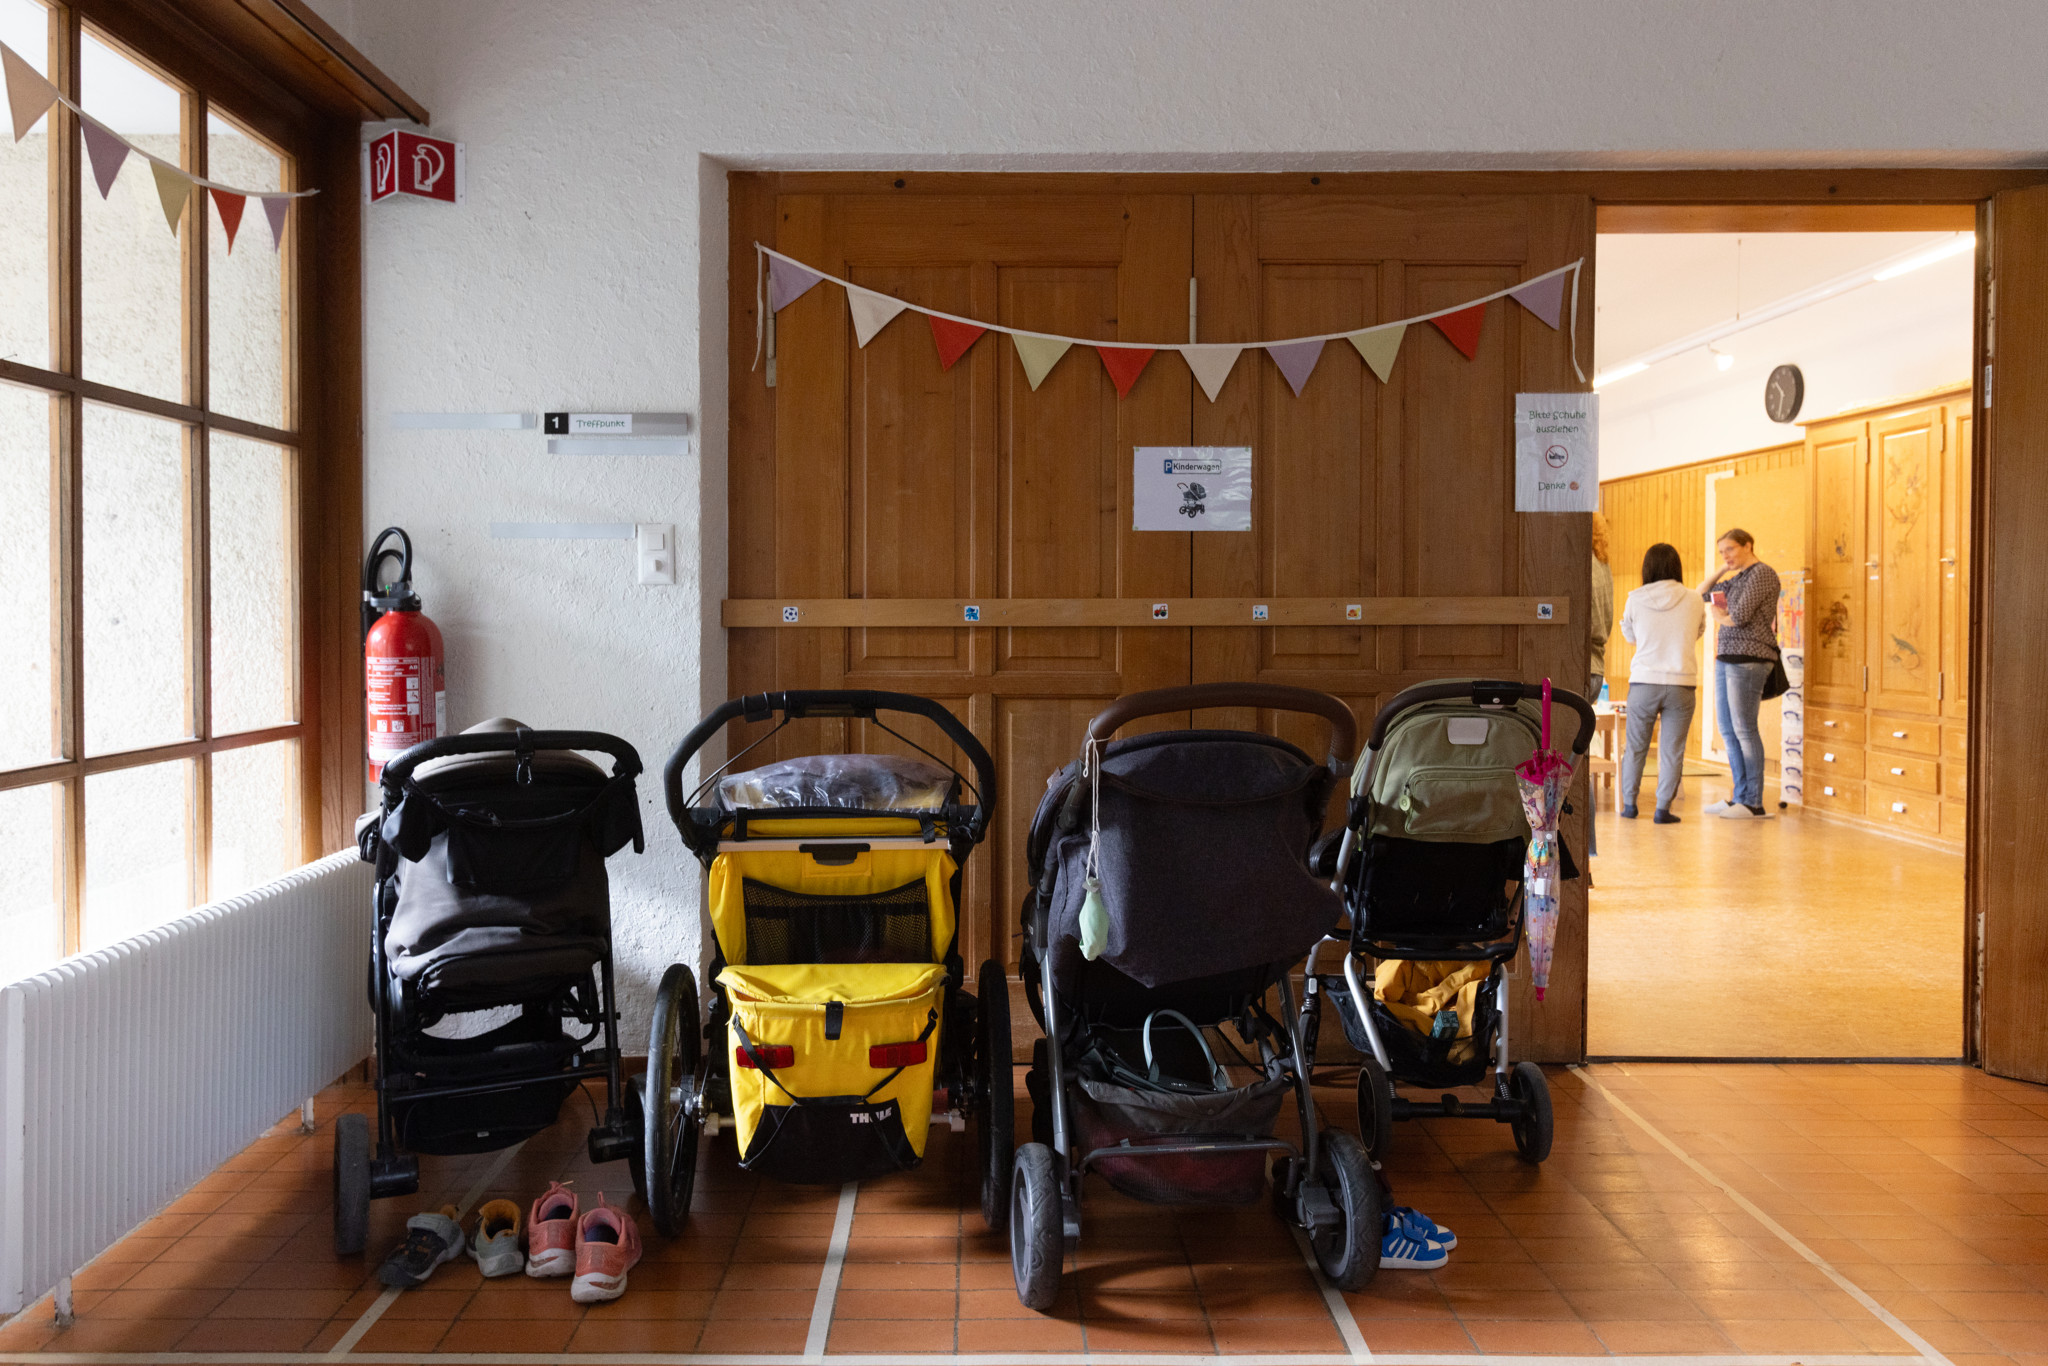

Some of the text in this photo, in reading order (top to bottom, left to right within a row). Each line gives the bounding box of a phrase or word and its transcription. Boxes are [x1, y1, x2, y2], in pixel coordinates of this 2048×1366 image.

[1528, 410, 1587, 421] Bitte Schuhe
[551, 416, 625, 429] 1 Treffpunkt
[1535, 425, 1579, 434] ausziehen
[1165, 461, 1220, 472] P Kinderwagen
[1538, 481, 1567, 491] Danke
